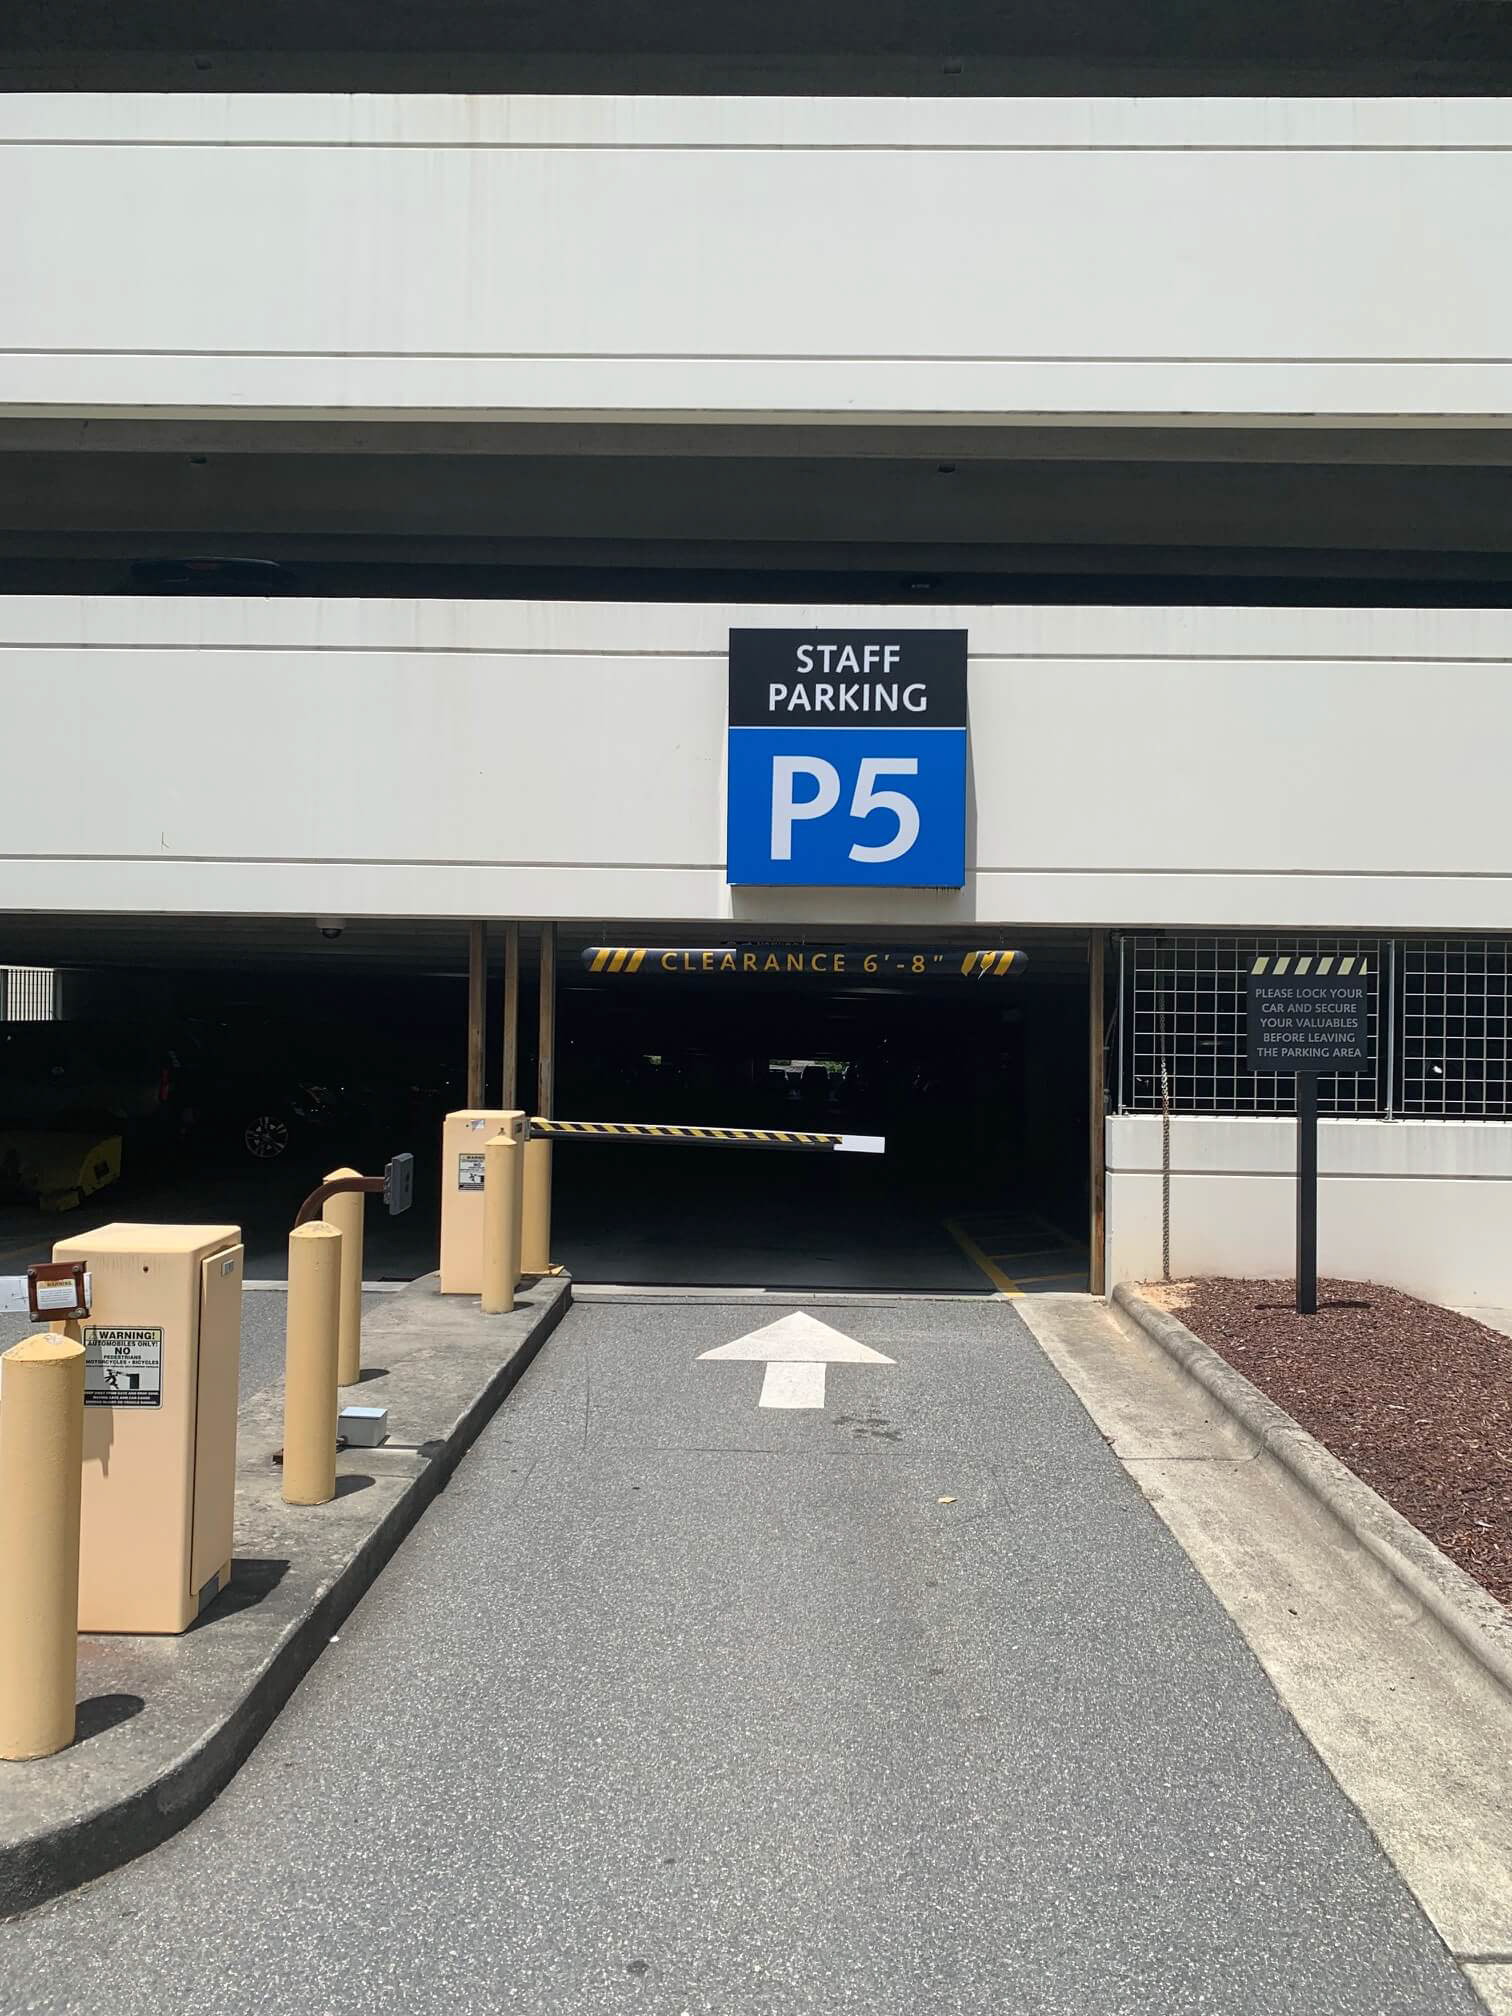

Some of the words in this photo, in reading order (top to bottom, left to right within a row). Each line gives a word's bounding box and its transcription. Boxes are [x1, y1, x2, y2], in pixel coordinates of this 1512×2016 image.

[796, 644, 901, 674] STAFF
[768, 683, 928, 712] PARKING
[770, 755, 921, 863] P5
[660, 952, 846, 972] CLEARANCE
[1255, 988, 1293, 999] PLEASE
[1296, 988, 1327, 999] LOCK
[1330, 989, 1363, 999] YOUR
[1261, 1003, 1285, 1013] CAR
[1287, 1003, 1312, 1013] AND
[1314, 1003, 1357, 1013] SECURE
[1260, 1018, 1293, 1028] YOUR
[1296, 1018, 1358, 1028] VALUABLES
[1263, 1033, 1305, 1042] BEFORE
[1308, 1033, 1355, 1042] LEAVING
[1257, 1048, 1278, 1057] THE
[1281, 1048, 1330, 1057] PARKING
[1332, 1048, 1362, 1057] AREA
[99, 1331, 155, 1340] WARNING!
[114, 1347, 131, 1355] NO
